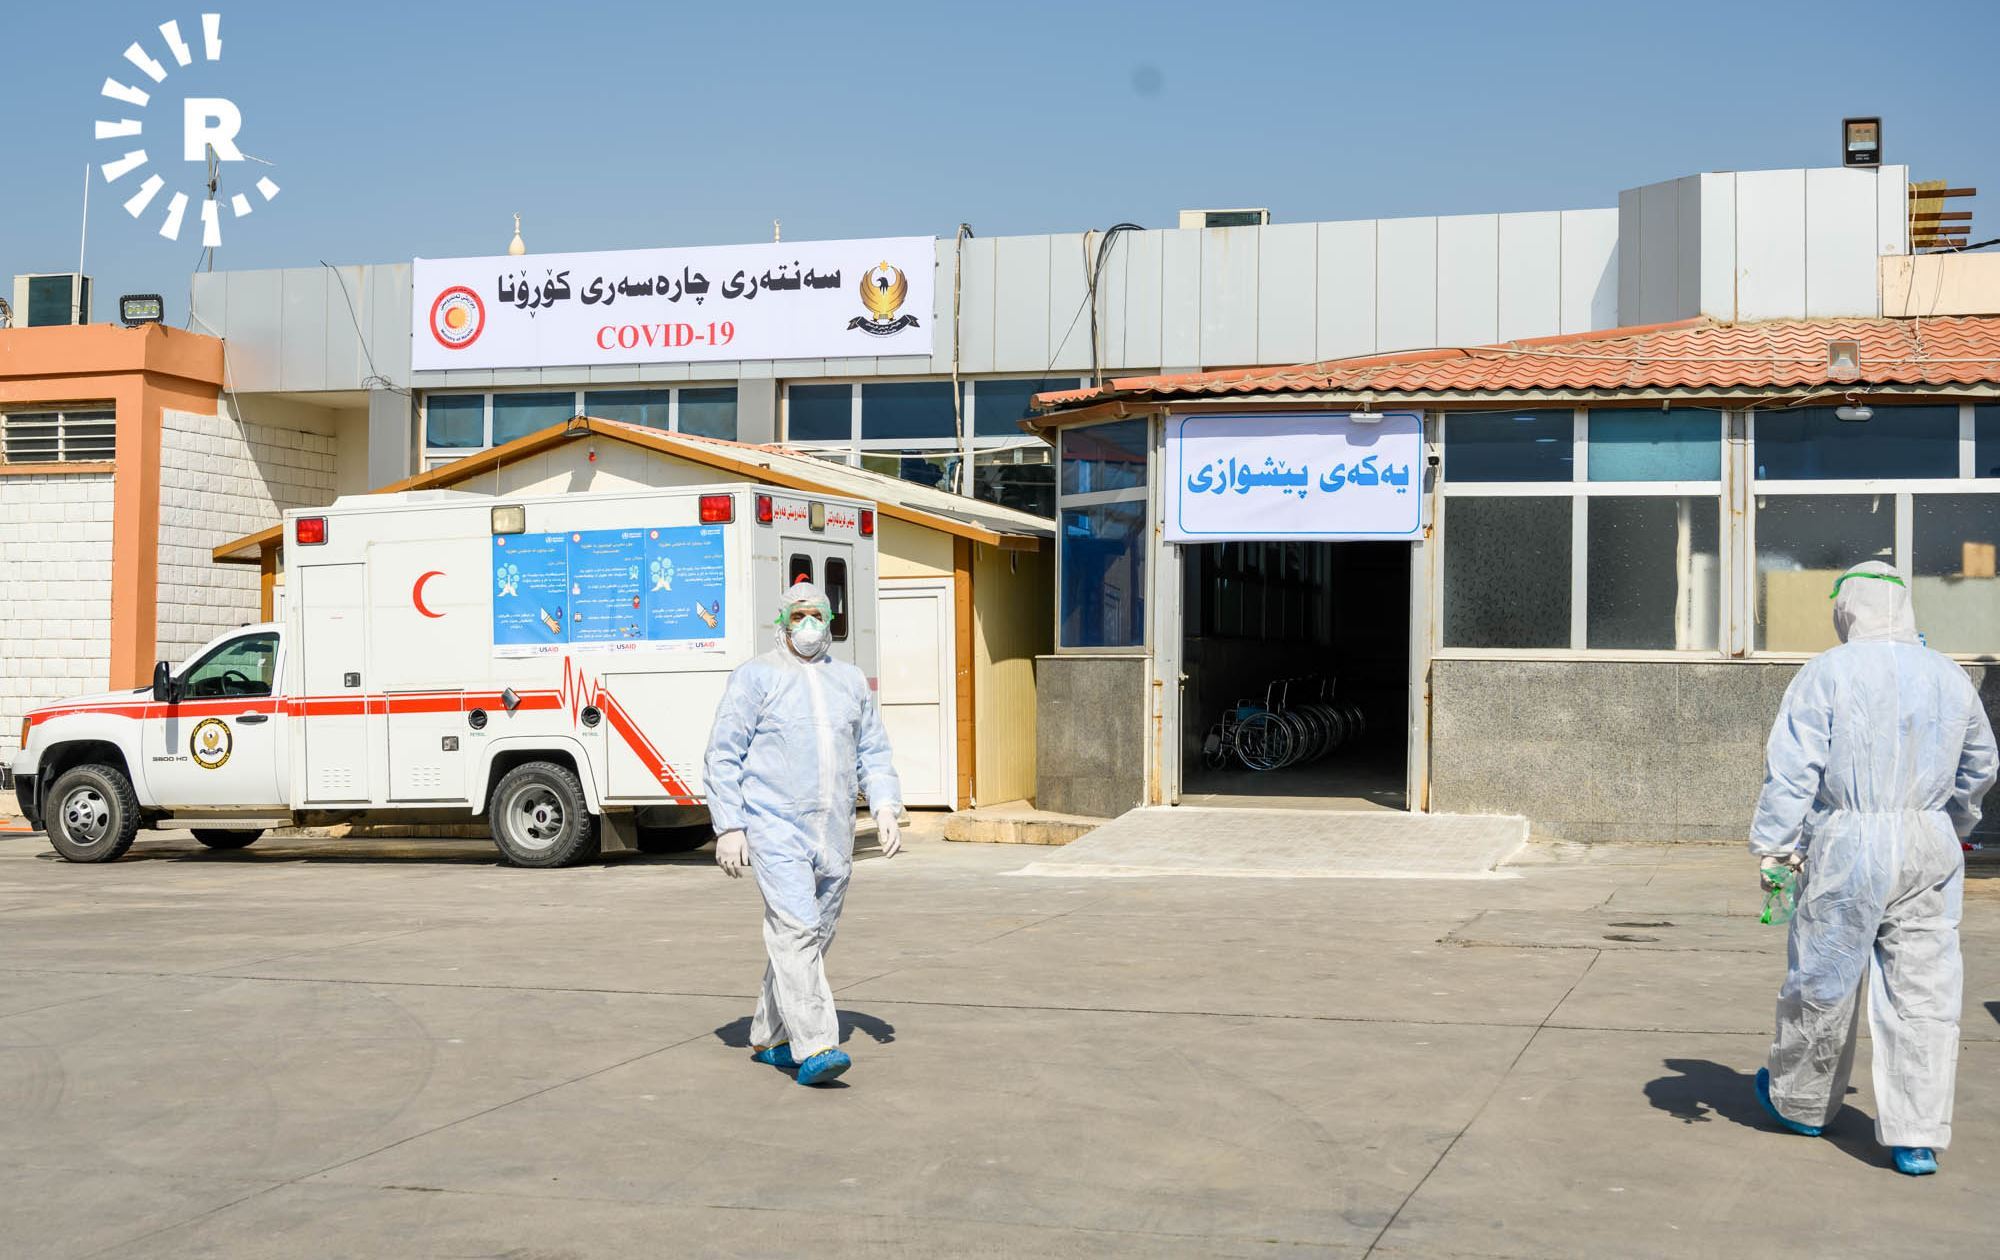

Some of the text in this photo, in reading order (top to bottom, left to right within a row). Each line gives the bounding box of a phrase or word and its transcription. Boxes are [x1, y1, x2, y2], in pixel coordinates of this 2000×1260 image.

[580, 265, 711, 306] چارەسەری
[722, 260, 841, 300] سەنتەری
[596, 321, 735, 351] COVID-19
[1186, 454, 1410, 500] یەکەی پێشوازی
[616, 643, 637, 651] USAID
[695, 641, 715, 649] USAID
